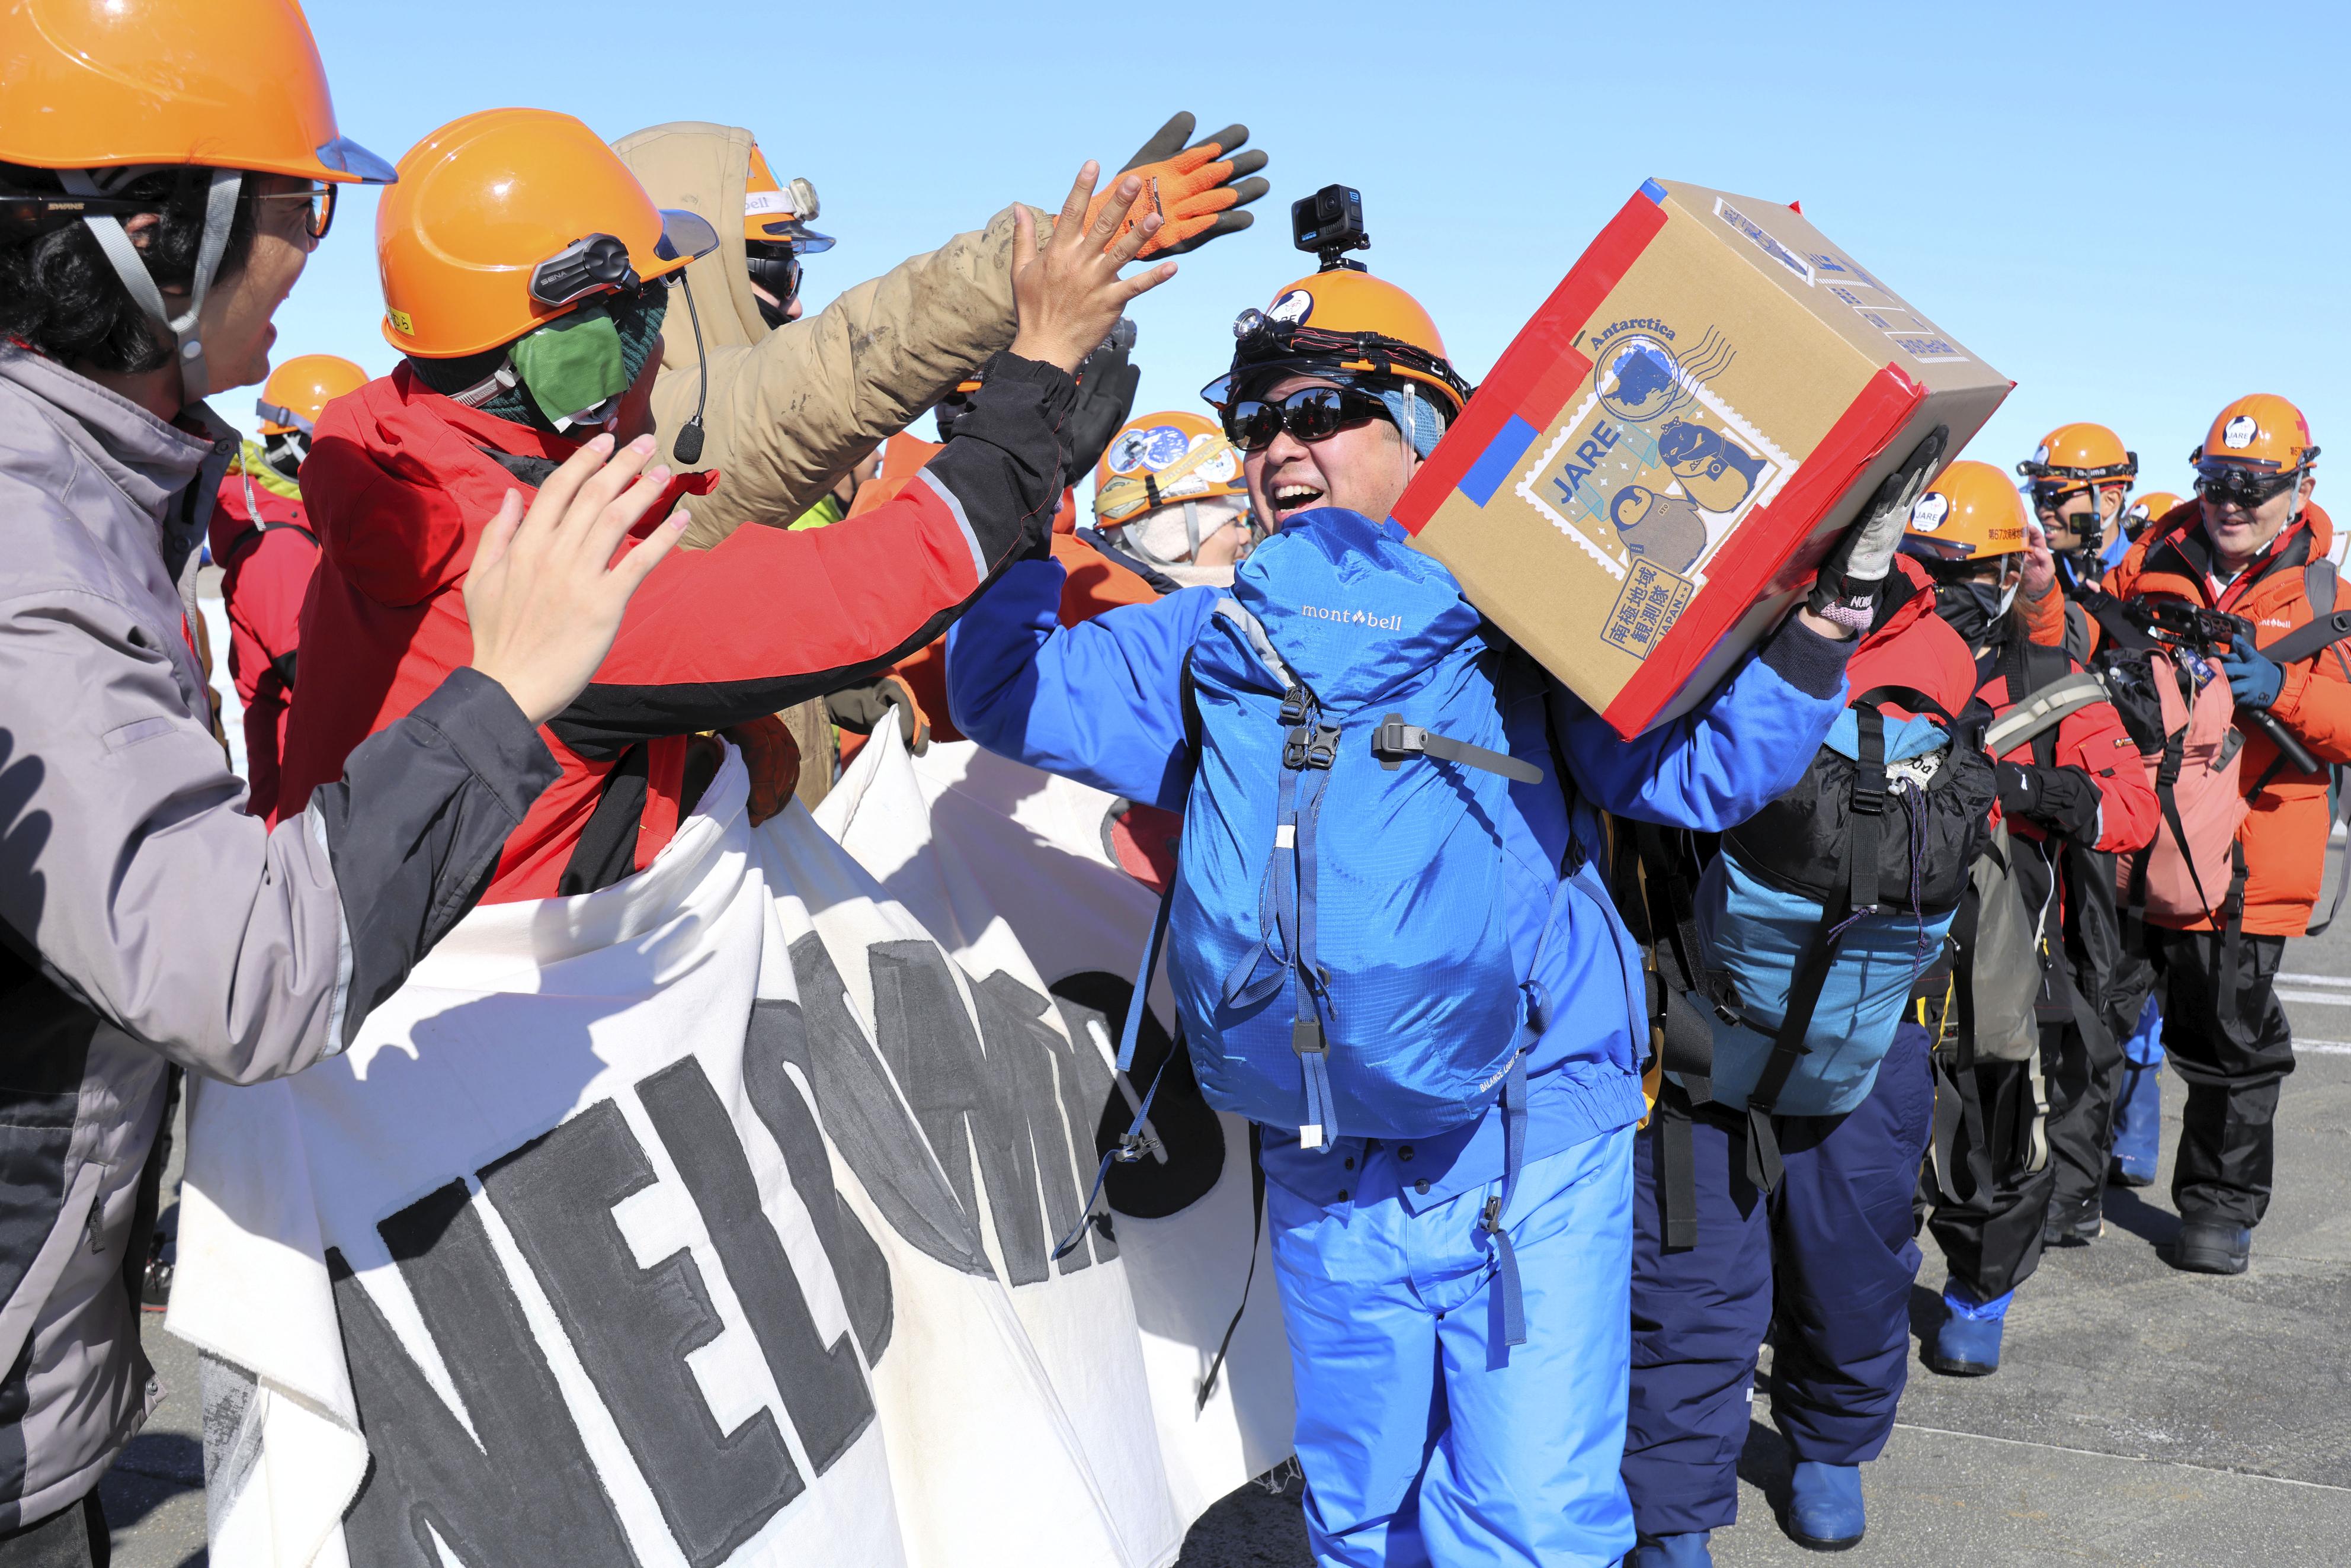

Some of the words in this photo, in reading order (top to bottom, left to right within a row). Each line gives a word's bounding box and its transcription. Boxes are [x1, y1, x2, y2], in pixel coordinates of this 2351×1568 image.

[47, 202, 85, 210] SWANS
[1349, 191, 1359, 200] 13
[540, 271, 567, 286] SENA
[1591, 318, 1676, 351] Antarctica
[1553, 419, 1622, 504] JARE
[1916, 512, 1938, 521] JARE
[1609, 566, 1657, 644] 南極地域
[1631, 585, 1670, 644] 観測隊
[1479, 1069, 1504, 1092] BALANCE
[1503, 1055, 1515, 1074] LIGHT
